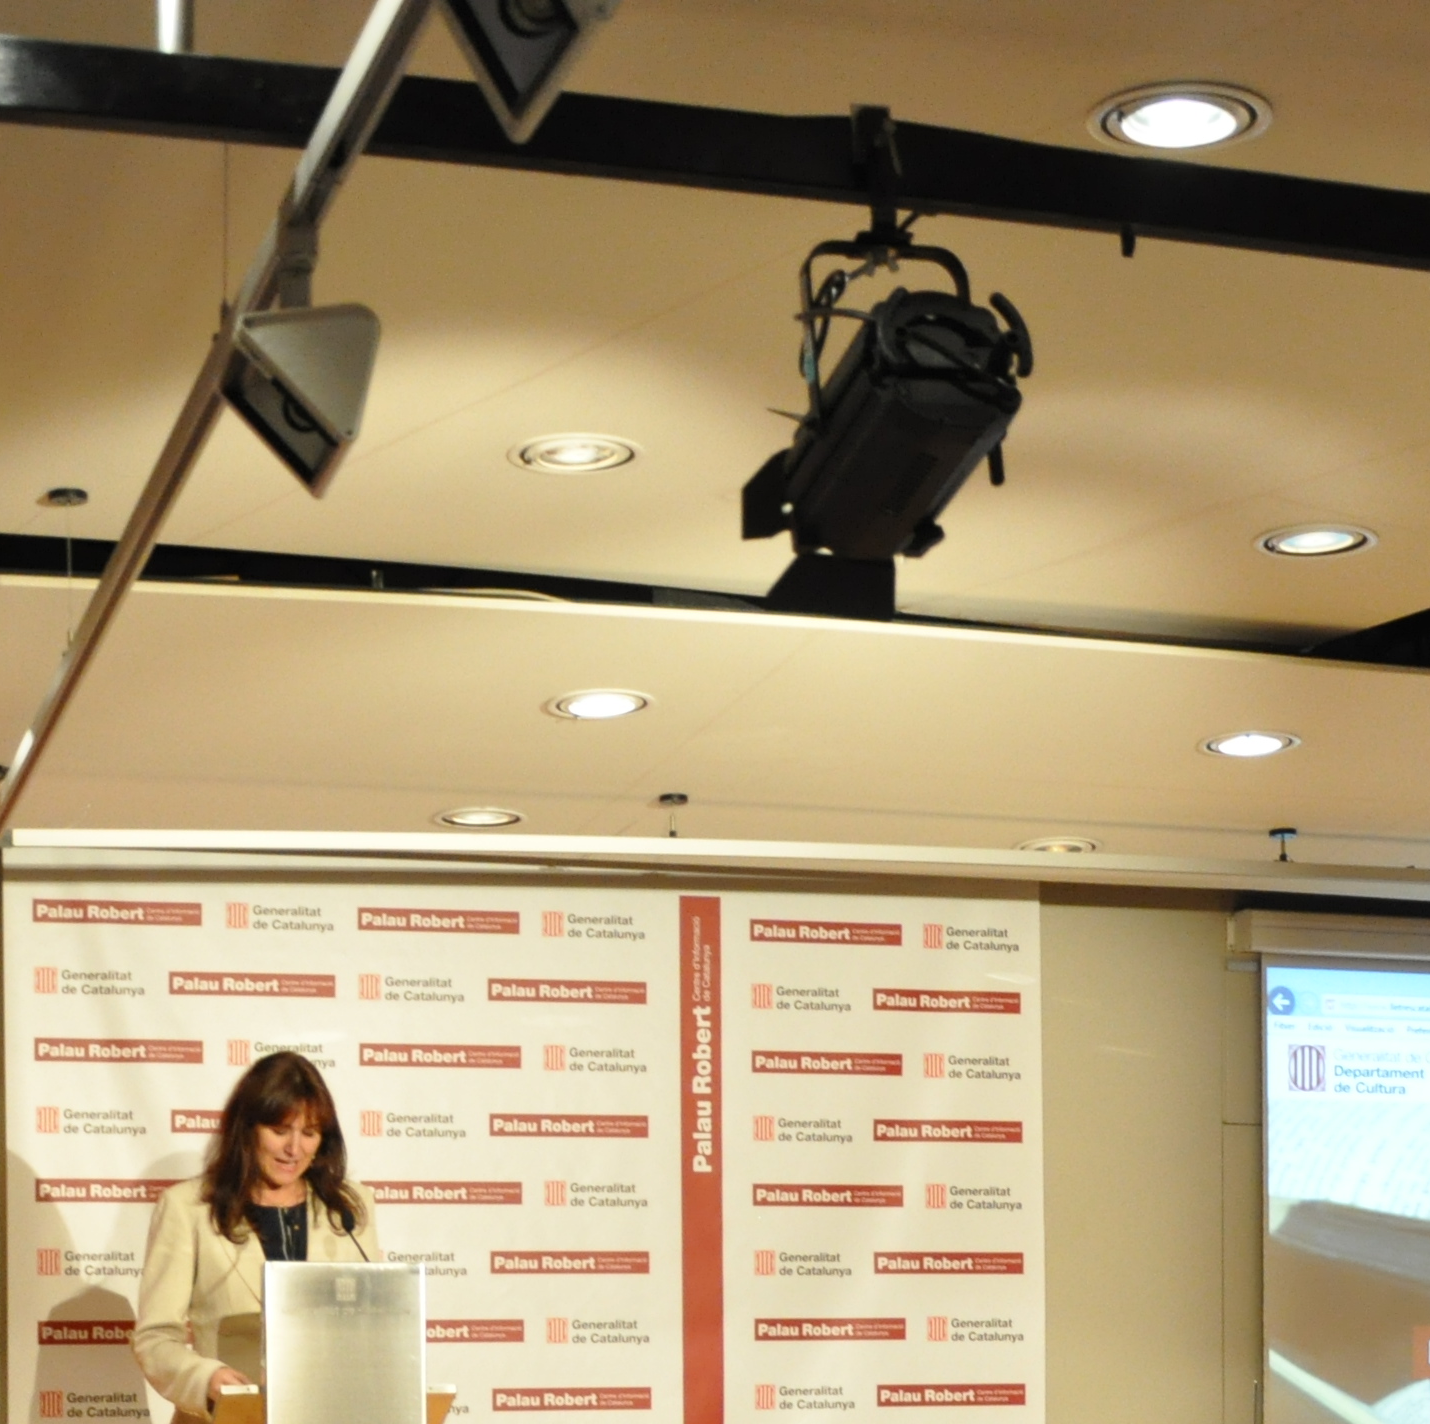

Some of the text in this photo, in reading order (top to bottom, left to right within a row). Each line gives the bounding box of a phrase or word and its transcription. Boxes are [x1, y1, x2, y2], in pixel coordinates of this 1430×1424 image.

[36, 905, 83, 920] Palau
[86, 905, 145, 921] Robert
[253, 905, 321, 917] Generalitat
[253, 920, 334, 932] de Catalunya
[361, 912, 406, 928] Palau
[410, 914, 465, 929] Robert
[567, 914, 634, 926] Generalitat
[567, 929, 645, 941] de Catalunya
[754, 925, 796, 938] Palau
[799, 926, 850, 940] Robert
[946, 927, 1008, 938] Generalitat
[946, 940, 1019, 953] de Catalunya
[61, 969, 132, 981] Generalitat
[702, 945, 712, 1001] de Catalunya
[172, 976, 219, 992] Palau
[223, 978, 279, 993] Robert
[385, 976, 453, 988] Generalitat
[692, 967, 701, 1001] Centre
[61, 984, 145, 997] de Catalunya
[385, 990, 464, 1003] de Catalunya
[492, 984, 536, 998] Palau
[540, 985, 593, 1000] Robert
[776, 987, 840, 999] Generalitat
[776, 1001, 852, 1013] de Catalunya
[876, 994, 917, 1008] Palau
[921, 995, 971, 1009] Robert
[38, 1043, 84, 1059] Palau
[88, 1044, 146, 1060] Robert
[362, 1049, 407, 1063] Palau
[411, 1049, 466, 1065] Robert
[569, 1047, 635, 1059] Generalitat
[569, 1062, 647, 1074] de Catalunya
[755, 1056, 798, 1070] Palau
[801, 1057, 853, 1071] Robert
[948, 1056, 1010, 1067] Generalitat
[948, 1069, 1021, 1081] de Catalunya
[1334, 1066, 1425, 1079] Departament
[692, 1006, 713, 1172] Palau Robert
[1334, 1082, 1406, 1095] de Cultura
[63, 1108, 133, 1121] Generalitat
[387, 1114, 454, 1126] Generalitat
[63, 1123, 146, 1137] de Catalunya
[493, 1119, 538, 1133] Palau
[542, 1120, 595, 1134] Robert
[778, 1119, 842, 1130] Generalitat
[387, 1128, 466, 1140] de Catalunya
[778, 1132, 853, 1145] de Catalunya
[877, 1125, 919, 1139] Palau
[922, 1125, 972, 1139] Robert
[40, 1183, 147, 1199] Palau Robert
[571, 1183, 636, 1194] Generalitat
[950, 1186, 1011, 1198] Generalitat
[756, 1188, 798, 1202] Palau
[802, 1189, 853, 1203] Robert
[571, 1197, 648, 1209] de Catalunya
[950, 1200, 1023, 1212] de Catalunya
[494, 1256, 539, 1270] Palau
[543, 1256, 595, 1270] Robert
[779, 1252, 840, 1263] Generalitat
[878, 1258, 919, 1271] Palau
[923, 1257, 973, 1271] Robert
[779, 1266, 852, 1278] de Catalunya
[572, 1320, 638, 1331] Generalitat
[951, 1318, 1013, 1329] Generalitat
[758, 1324, 799, 1338] Palau
[803, 1324, 854, 1337] Robert
[572, 1334, 650, 1346] de Catalunya
[951, 1332, 1024, 1344] de Catalunya
[67, 1392, 137, 1404] Generalitat
[779, 1386, 843, 1397] Generalitat
[880, 1389, 921, 1402] Palau
[925, 1389, 975, 1402] Robert
[496, 1393, 540, 1407] Palau
[544, 1392, 597, 1406] Robert
[779, 1400, 855, 1412] de Catalunya
[67, 1407, 151, 1420] de Catalunya
